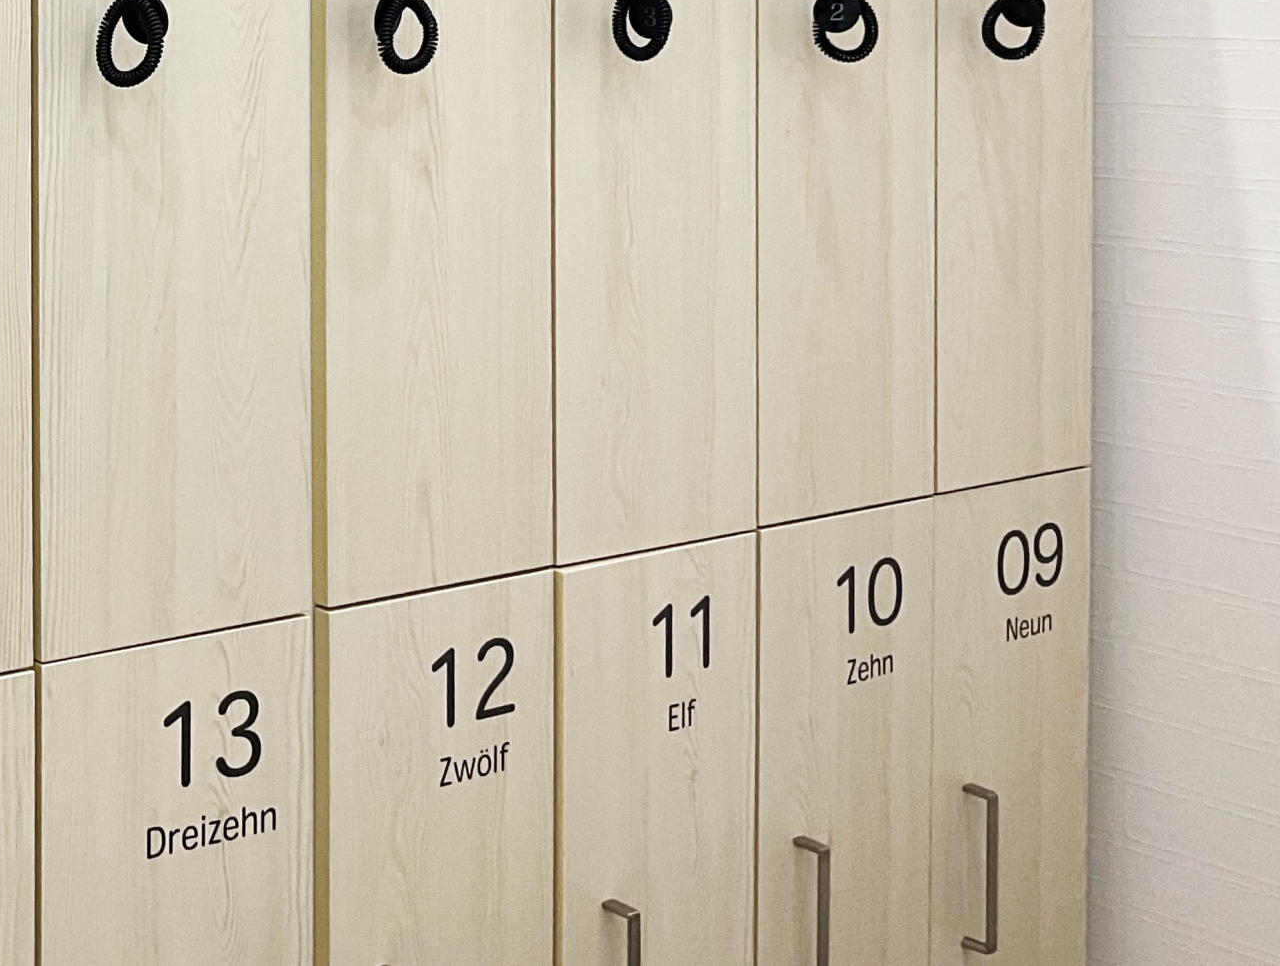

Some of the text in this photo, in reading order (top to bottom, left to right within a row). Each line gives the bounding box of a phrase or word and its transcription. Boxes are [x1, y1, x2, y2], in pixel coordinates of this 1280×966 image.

[829, 1, 845, 22] 2
[997, 522, 1064, 596] 09
[836, 556, 903, 634] 10
[652, 595, 711, 679] 11
[1006, 613, 1053, 643] Neun
[431, 637, 516, 729] 12
[846, 653, 894, 686] Zehn
[163, 690, 262, 788] 13
[668, 698, 697, 732] Elf
[439, 741, 510, 788] Zwölf
[146, 806, 277, 860] Dreizehn
